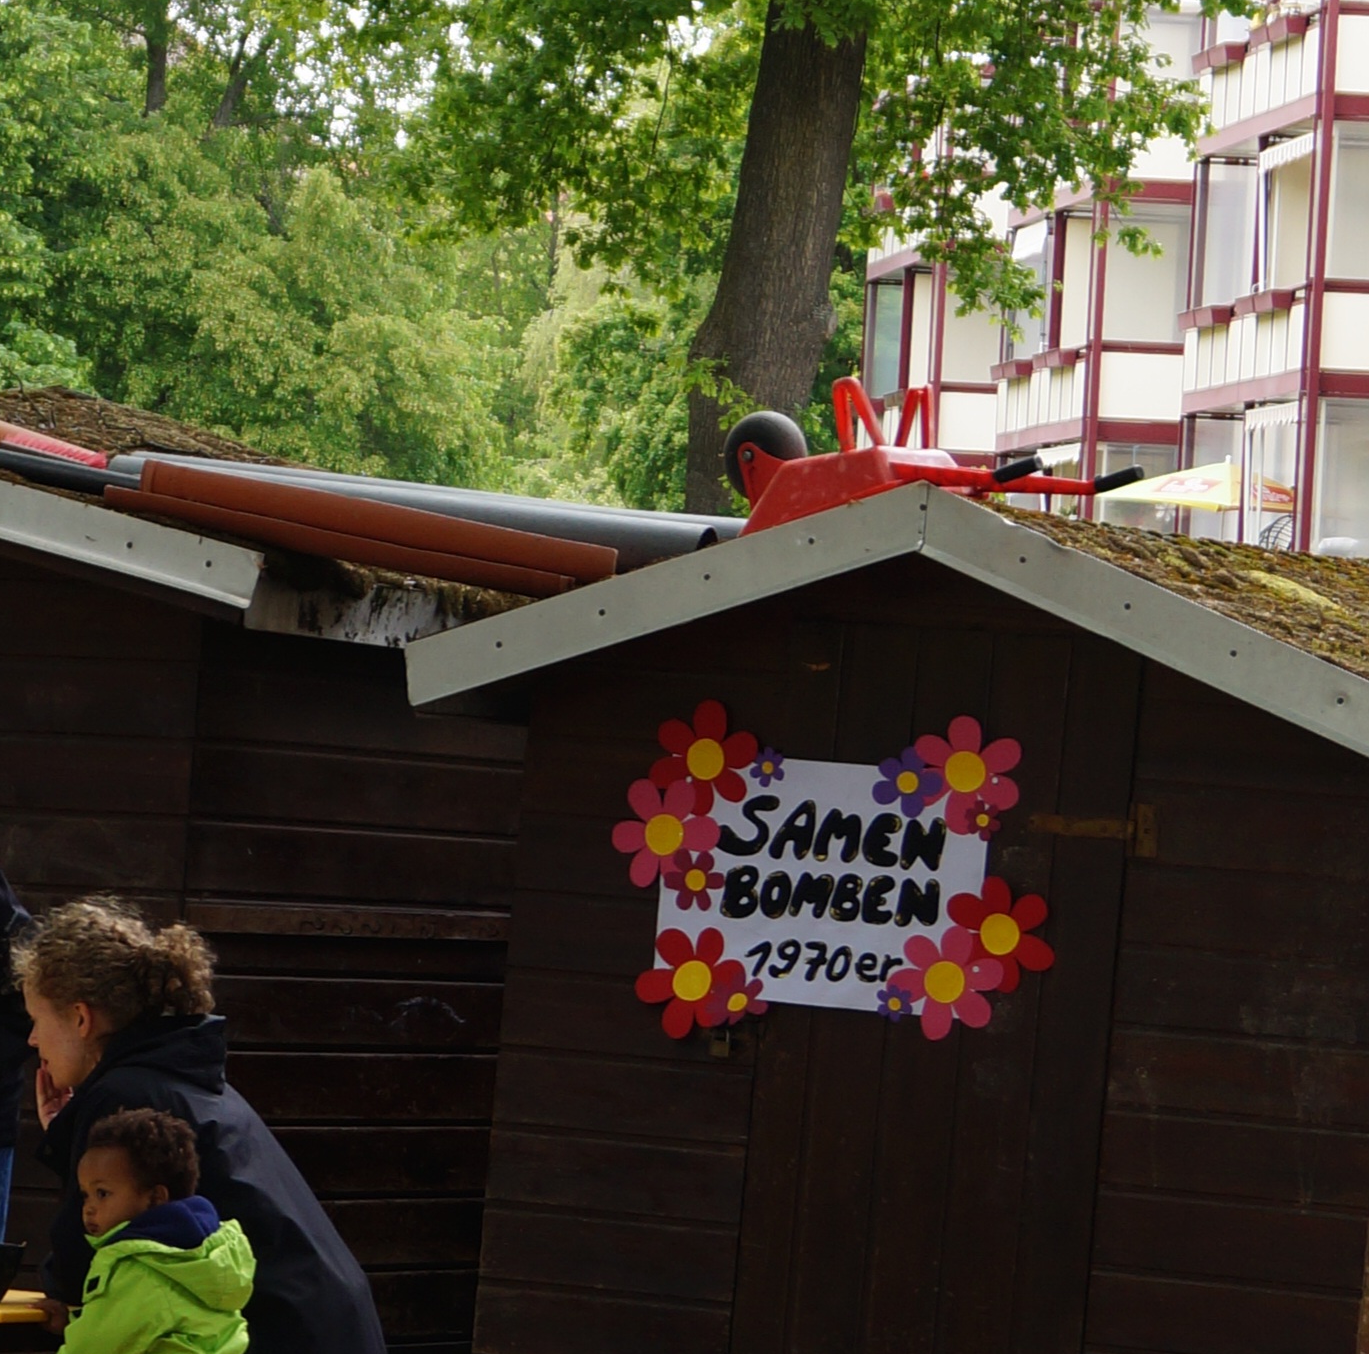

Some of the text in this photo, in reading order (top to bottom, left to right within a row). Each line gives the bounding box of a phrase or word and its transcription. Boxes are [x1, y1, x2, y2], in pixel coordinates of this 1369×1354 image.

[718, 795, 946, 871] SAMEN
[720, 864, 940, 927] BOMBEN
[744, 938, 903, 983] 1970er
